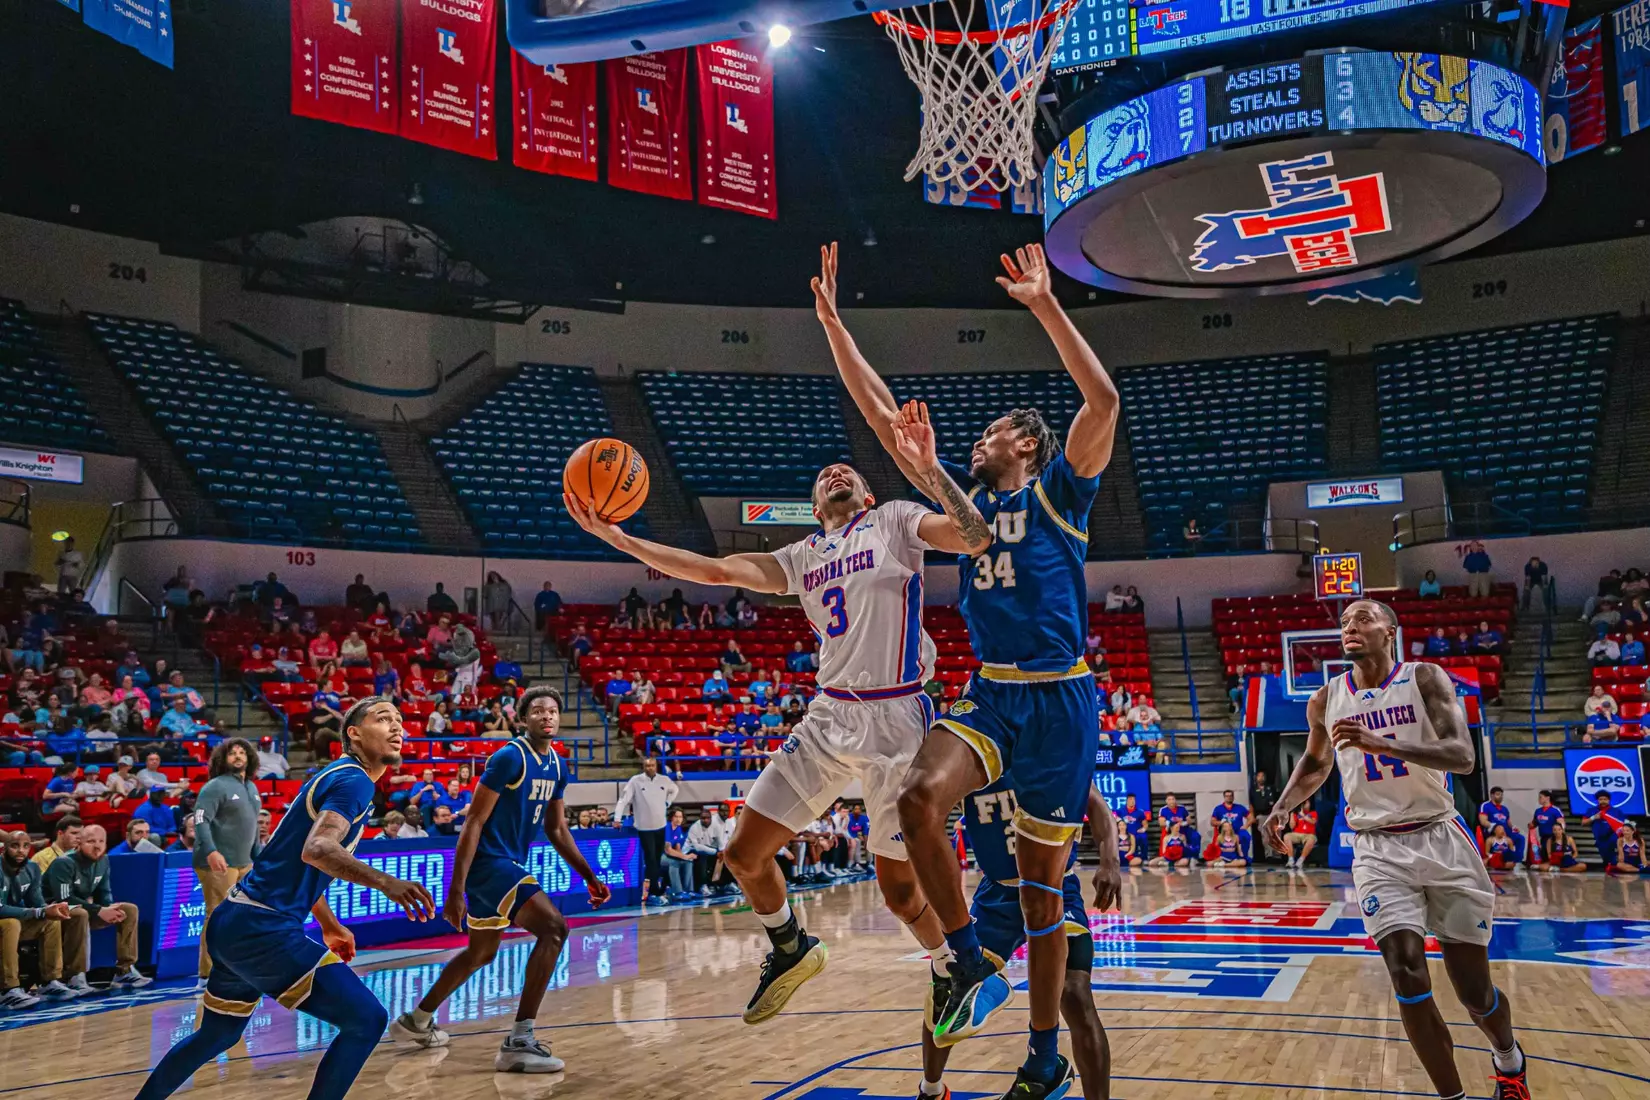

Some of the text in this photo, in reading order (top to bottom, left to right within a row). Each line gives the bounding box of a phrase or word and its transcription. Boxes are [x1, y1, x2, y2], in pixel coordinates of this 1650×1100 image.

[421, 0, 482, 22] BULLDOGS
[1220, 0, 1250, 23] 18
[1612, 0, 1650, 35] TERE
[711, 44, 758, 63] LOUISIANA
[1072, 48, 1081, 60] 0
[328, 64, 365, 78] SUNBELT
[626, 65, 666, 81] BULLDOGS
[722, 58, 747, 71] TECH
[1055, 59, 1117, 76] DAKTRONICS
[320, 73, 374, 91] CONFERENCE
[709, 65, 761, 84] UNIVERSITY
[1178, 84, 1193, 104] 3
[1225, 63, 1301, 92] ASSISTS
[323, 85, 371, 101] CHAMPIONS
[711, 76, 760, 94] BULLDOGS
[433, 90, 467, 105] SUNBELT
[1179, 81, 1354, 128] 2 STEALS 3
[425, 99, 475, 118] CONFERENCE
[428, 110, 471, 127] CHAMPIONS
[1179, 105, 1355, 152] 7 TURNOVERS 4
[109, 262, 147, 284] 204
[1472, 279, 1507, 299] 209
[541, 318, 571, 335] 205
[1202, 313, 1233, 330] 208
[721, 329, 749, 344] 206
[958, 328, 986, 343] 207
[16, 462, 53, 472] Knighton
[286, 550, 316, 567] 103
[846, 549, 874, 575] TECH
[1323, 557, 1356, 571] 11:20
[974, 551, 1016, 590] 34
[1324, 571, 1353, 594] 22
[822, 586, 849, 638] 3
[1386, 704, 1417, 727] TECH
[1364, 732, 1410, 782] 14
[528, 779, 556, 801] FIU
[1577, 775, 1632, 787] PEPSI
[303, 853, 445, 924] REMIER
